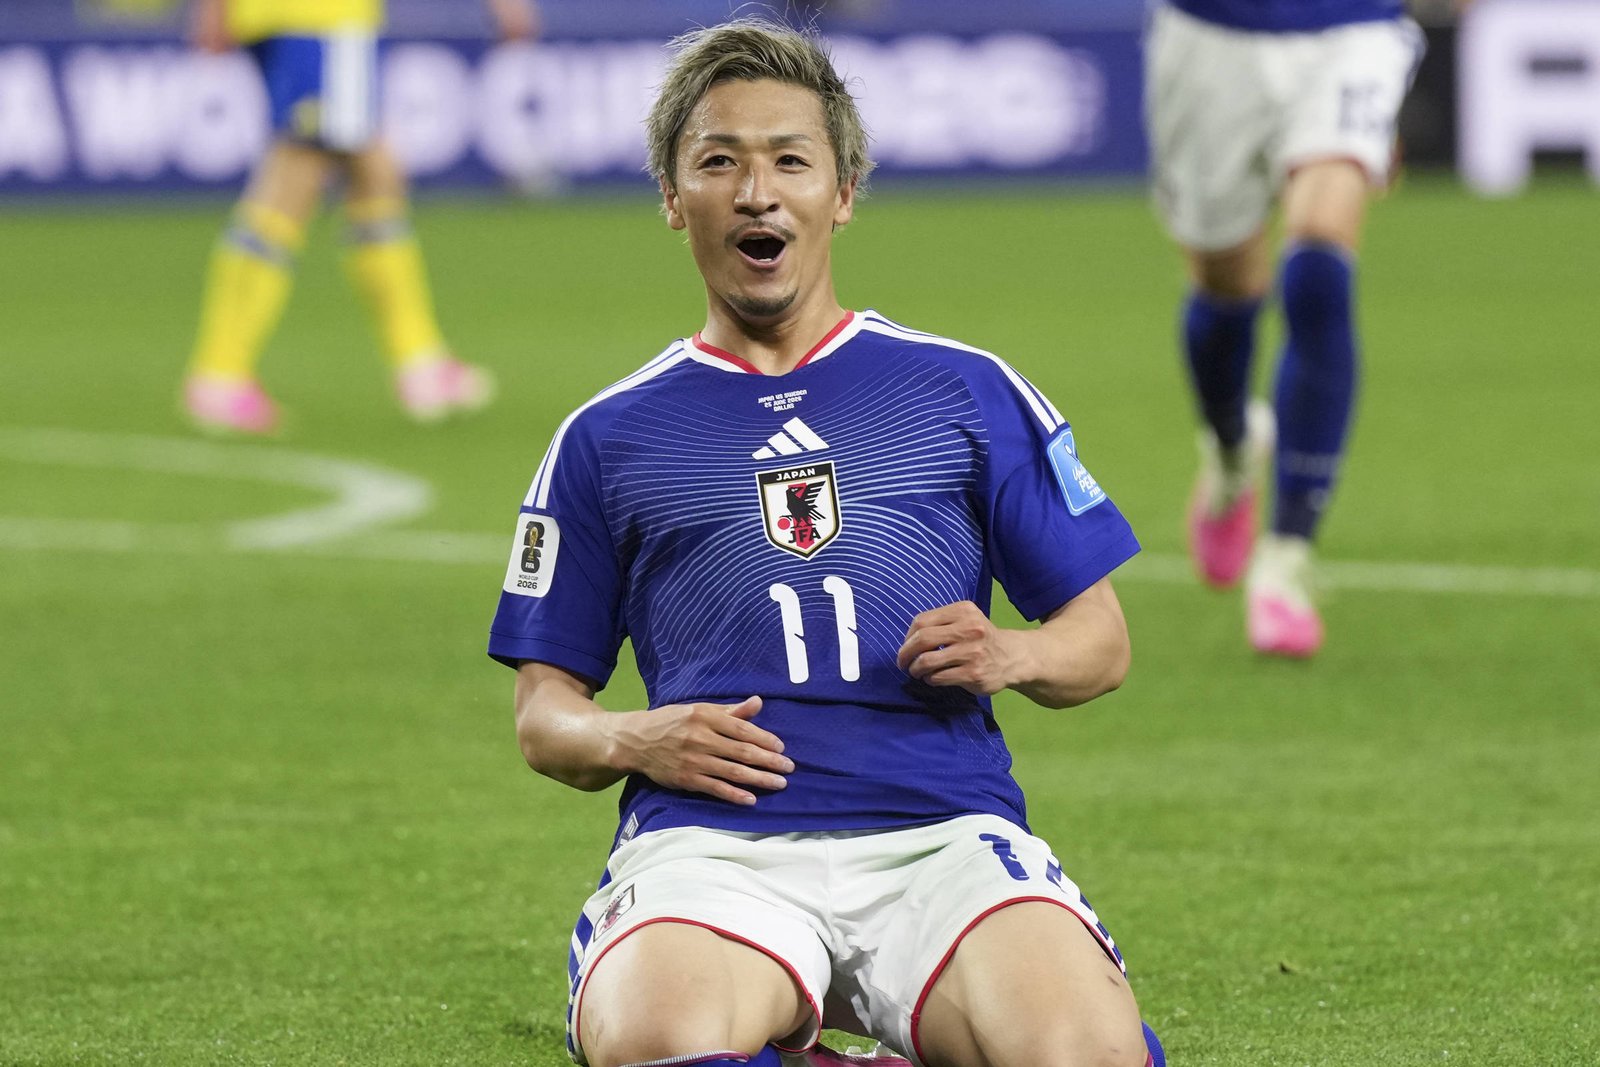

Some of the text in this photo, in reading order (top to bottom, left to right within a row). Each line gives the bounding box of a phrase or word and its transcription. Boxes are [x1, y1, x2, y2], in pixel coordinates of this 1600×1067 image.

[758, 396, 774, 404] JAPAN
[784, 390, 807, 398] SWEDEN
[774, 403, 794, 412] DALLAS
[776, 468, 816, 481] JAPAN
[788, 527, 821, 543] JFA
[517, 580, 538, 590] 2026
[769, 575, 860, 684] 11
